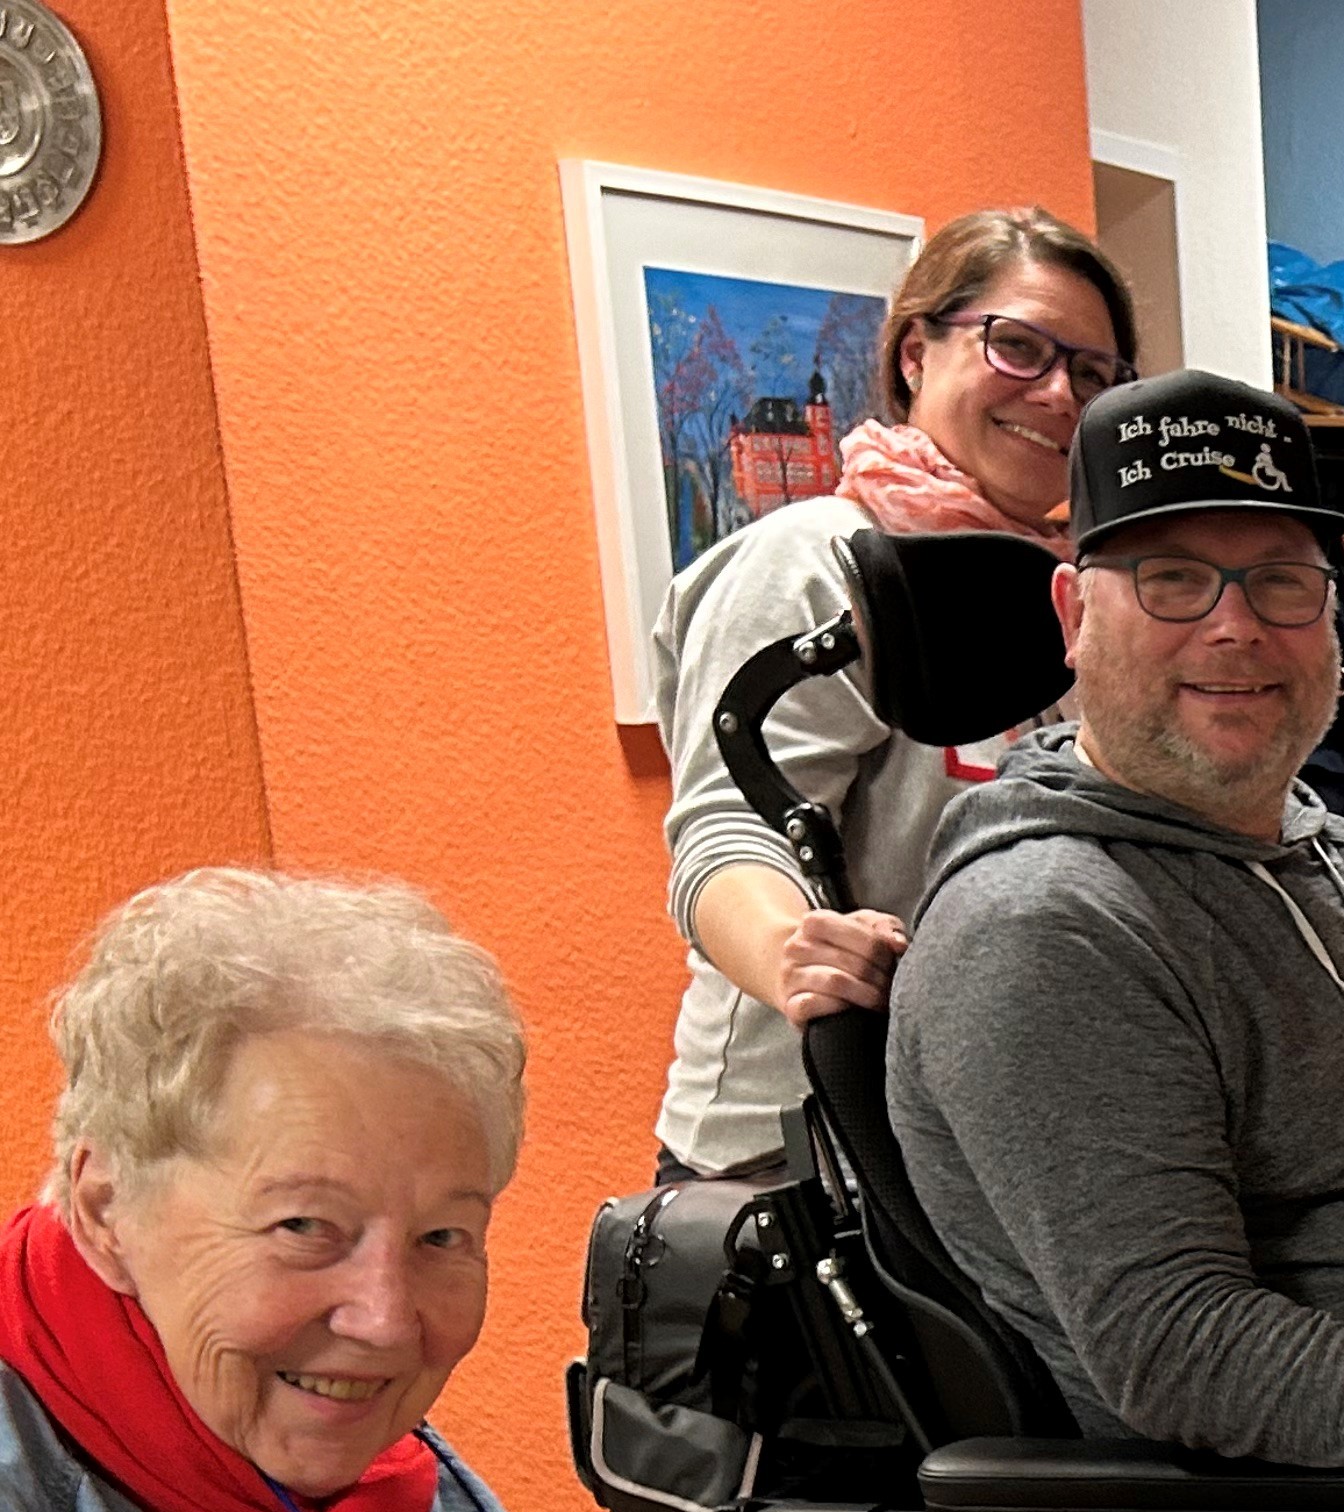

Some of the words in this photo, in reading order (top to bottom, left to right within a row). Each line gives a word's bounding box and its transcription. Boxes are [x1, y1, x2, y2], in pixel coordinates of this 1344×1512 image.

[1118, 415, 1152, 443] Ich
[1159, 416, 1220, 447] fahre
[1225, 413, 1277, 439] nicht
[1118, 460, 1152, 488] Ich
